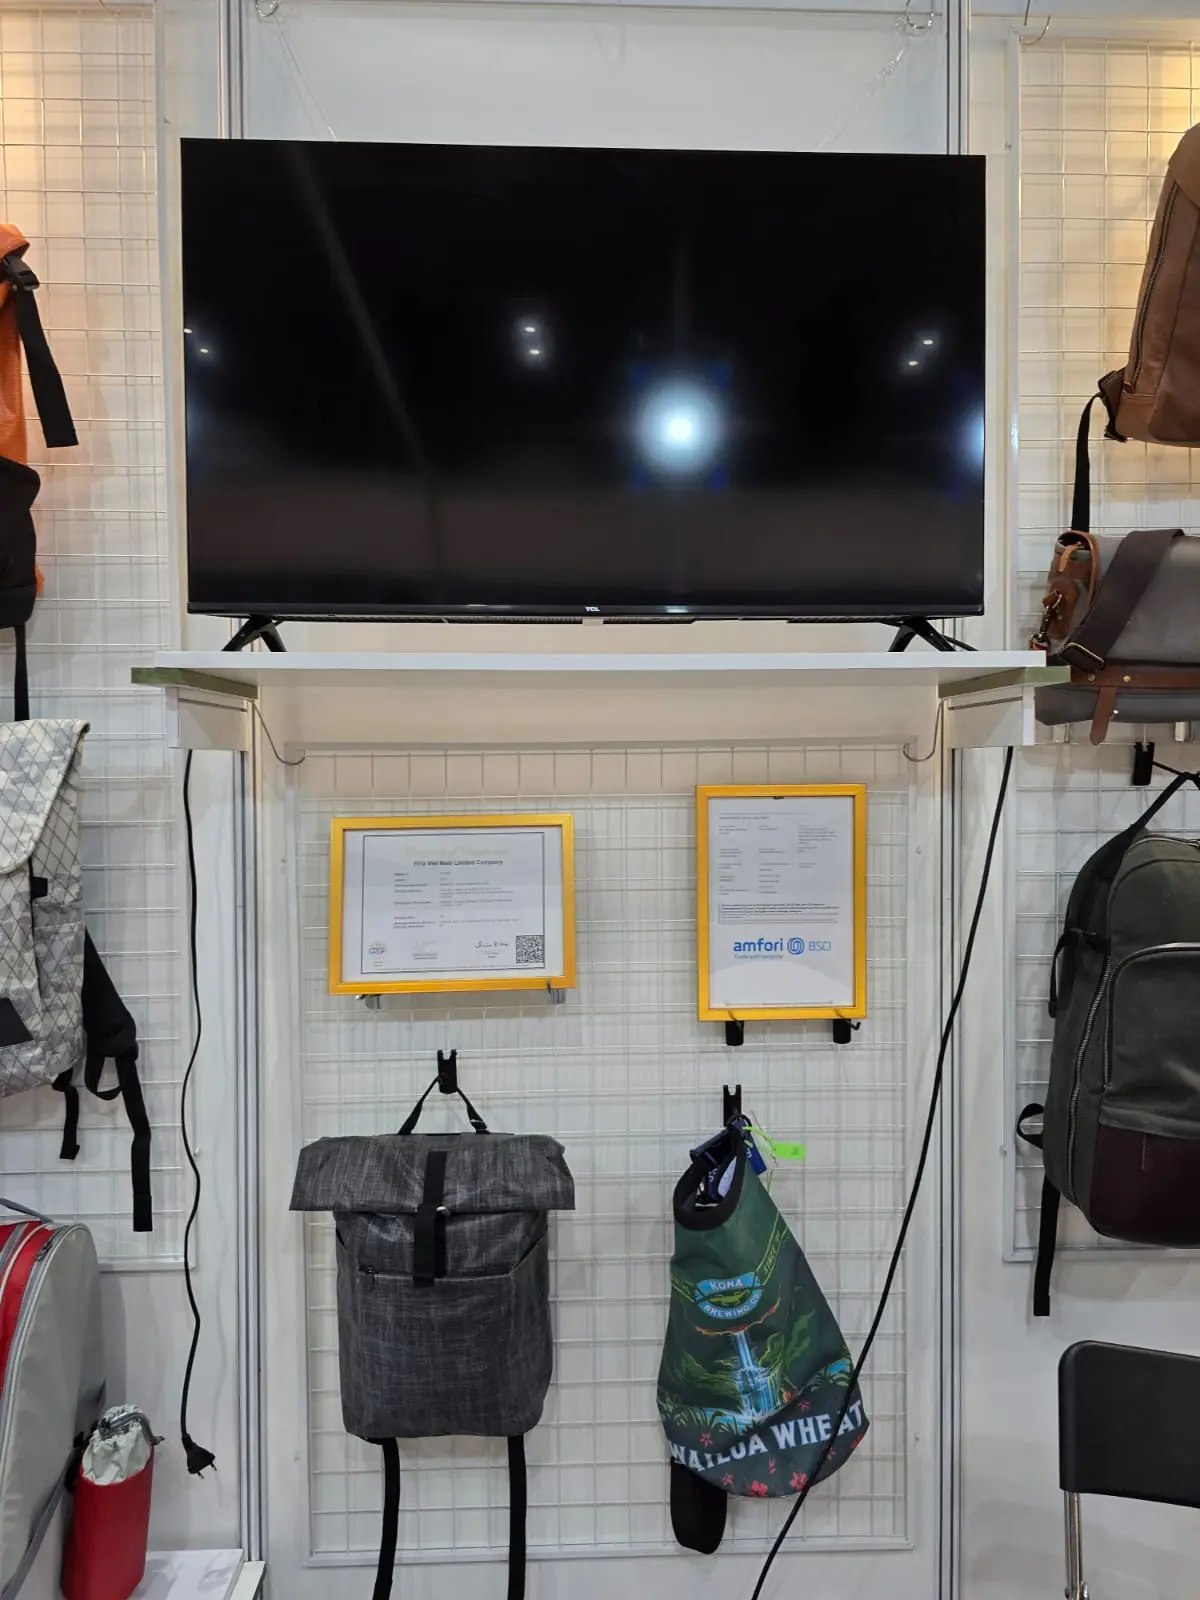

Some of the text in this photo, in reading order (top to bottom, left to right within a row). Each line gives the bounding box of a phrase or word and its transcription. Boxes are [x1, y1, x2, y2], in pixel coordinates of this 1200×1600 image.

[454, 859, 475, 867] Limited
[476, 859, 504, 867] Company
[733, 937, 832, 952] amfori BSCI
[709, 1278, 743, 1291] KONA
[703, 1303, 751, 1318] BREWING
[668, 1399, 864, 1472] WAILUA WHEAT
